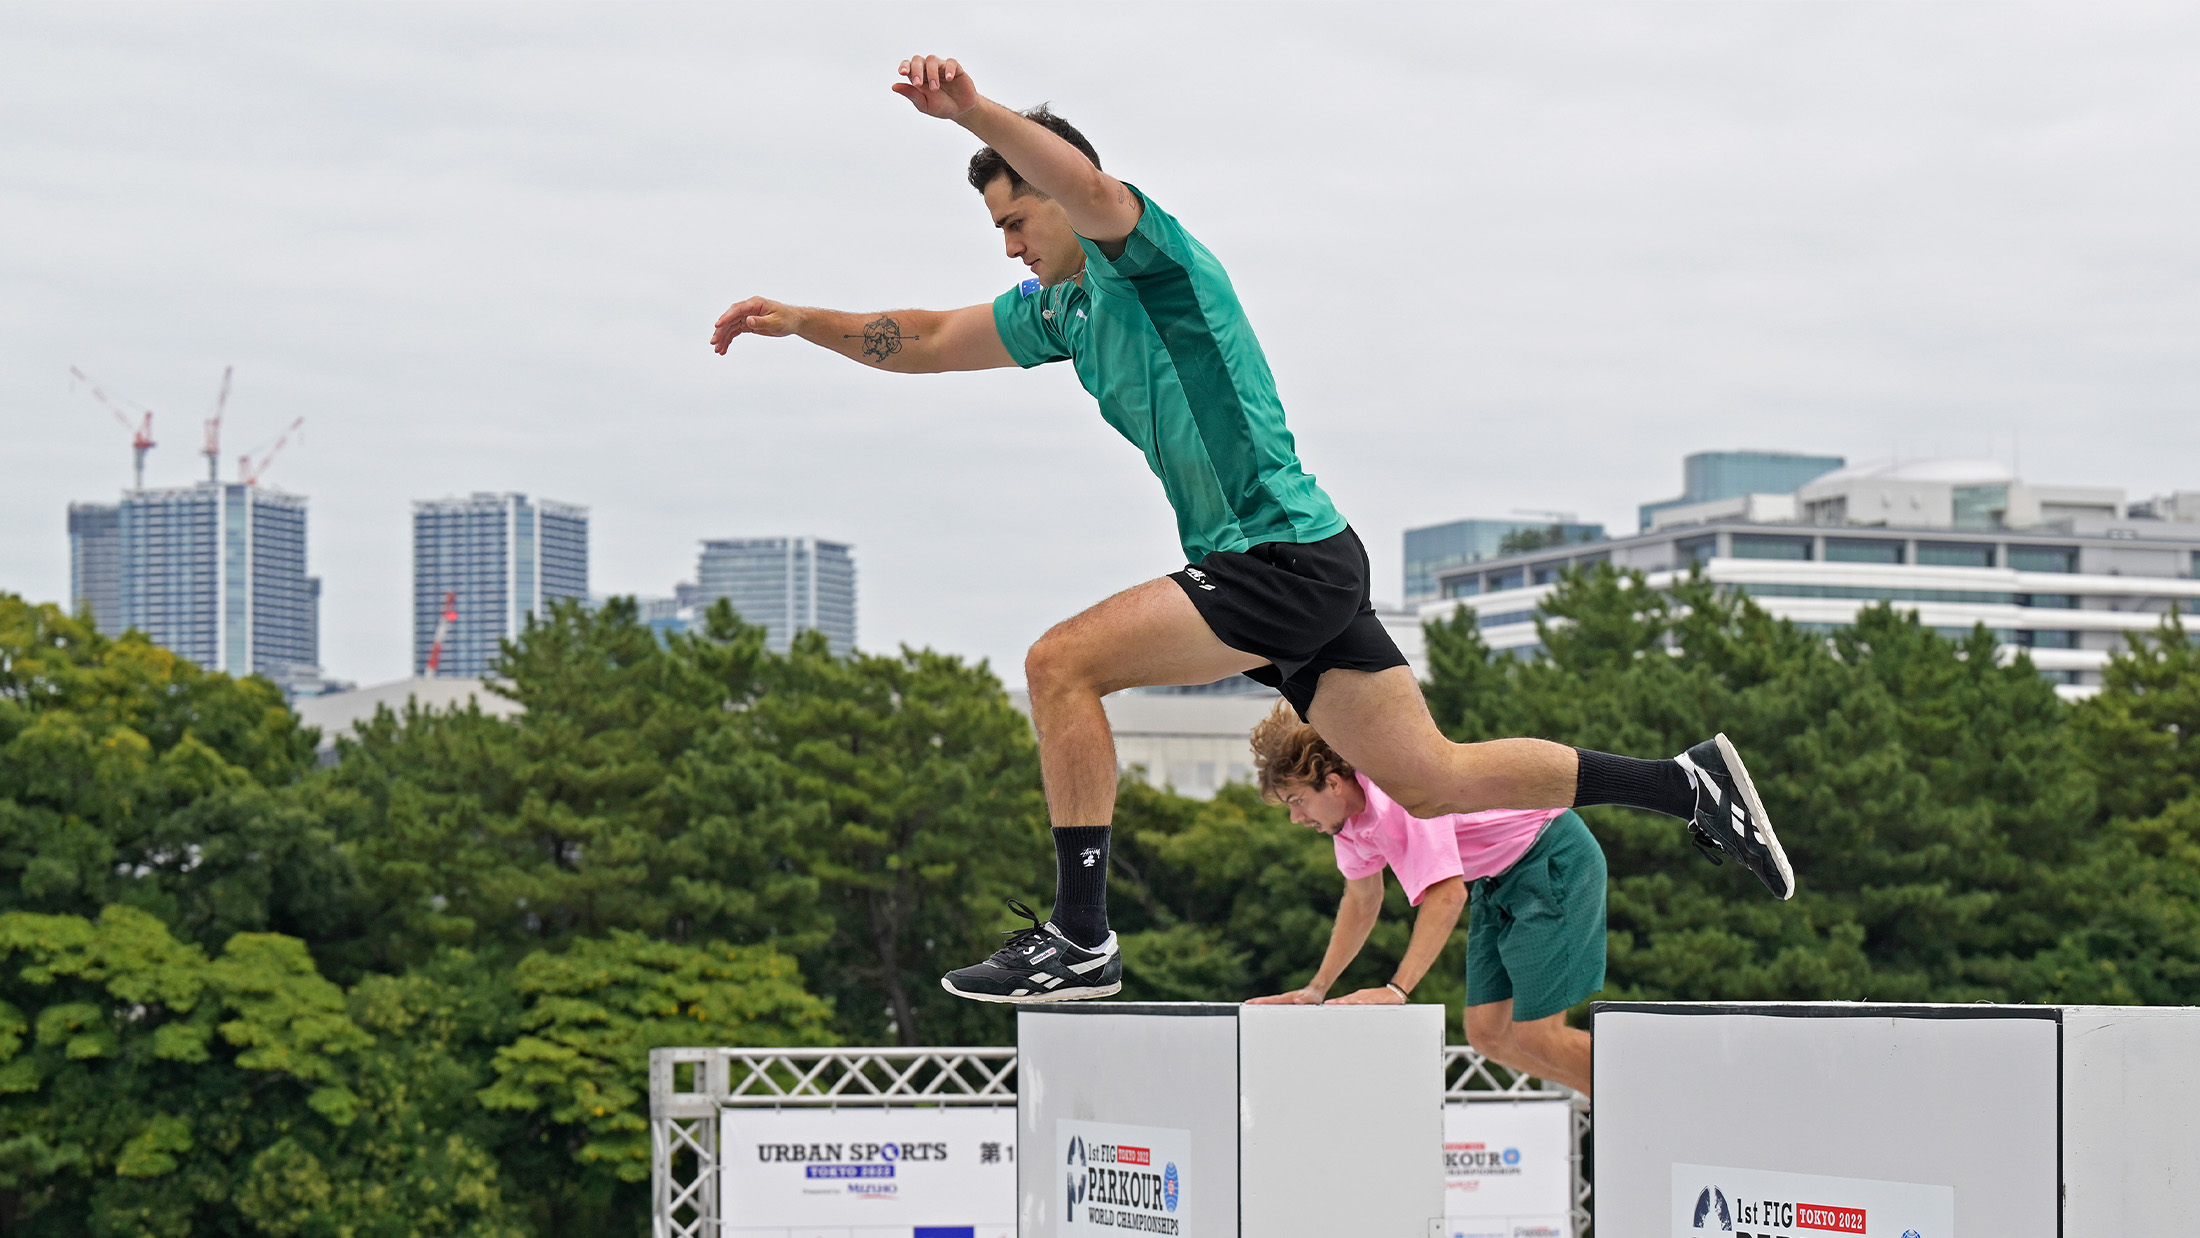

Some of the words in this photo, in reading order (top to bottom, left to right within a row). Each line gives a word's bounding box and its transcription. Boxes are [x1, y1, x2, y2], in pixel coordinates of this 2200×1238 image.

[758, 1144, 843, 1162] URBAN
[849, 1142, 948, 1162] SPORTS
[1088, 1143, 1100, 1162] 1st
[1101, 1144, 1116, 1163] FIG
[1118, 1147, 1136, 1161] TOKYO
[1137, 1149, 1149, 1163] 2022
[1445, 1152, 1501, 1166] KOUR
[811, 1166, 858, 1178] TOKYO
[860, 1166, 891, 1178] 2022
[1088, 1166, 1163, 1211] PARKOUR
[1088, 1207, 1114, 1226] WORLD
[1117, 1211, 1179, 1236] CHAMPIONSHIPS
[1737, 1198, 1758, 1225] 1st
[1763, 1201, 1793, 1228] FIG
[1799, 1208, 1836, 1227] TOKYO
[1839, 1212, 1863, 1229] 2022
